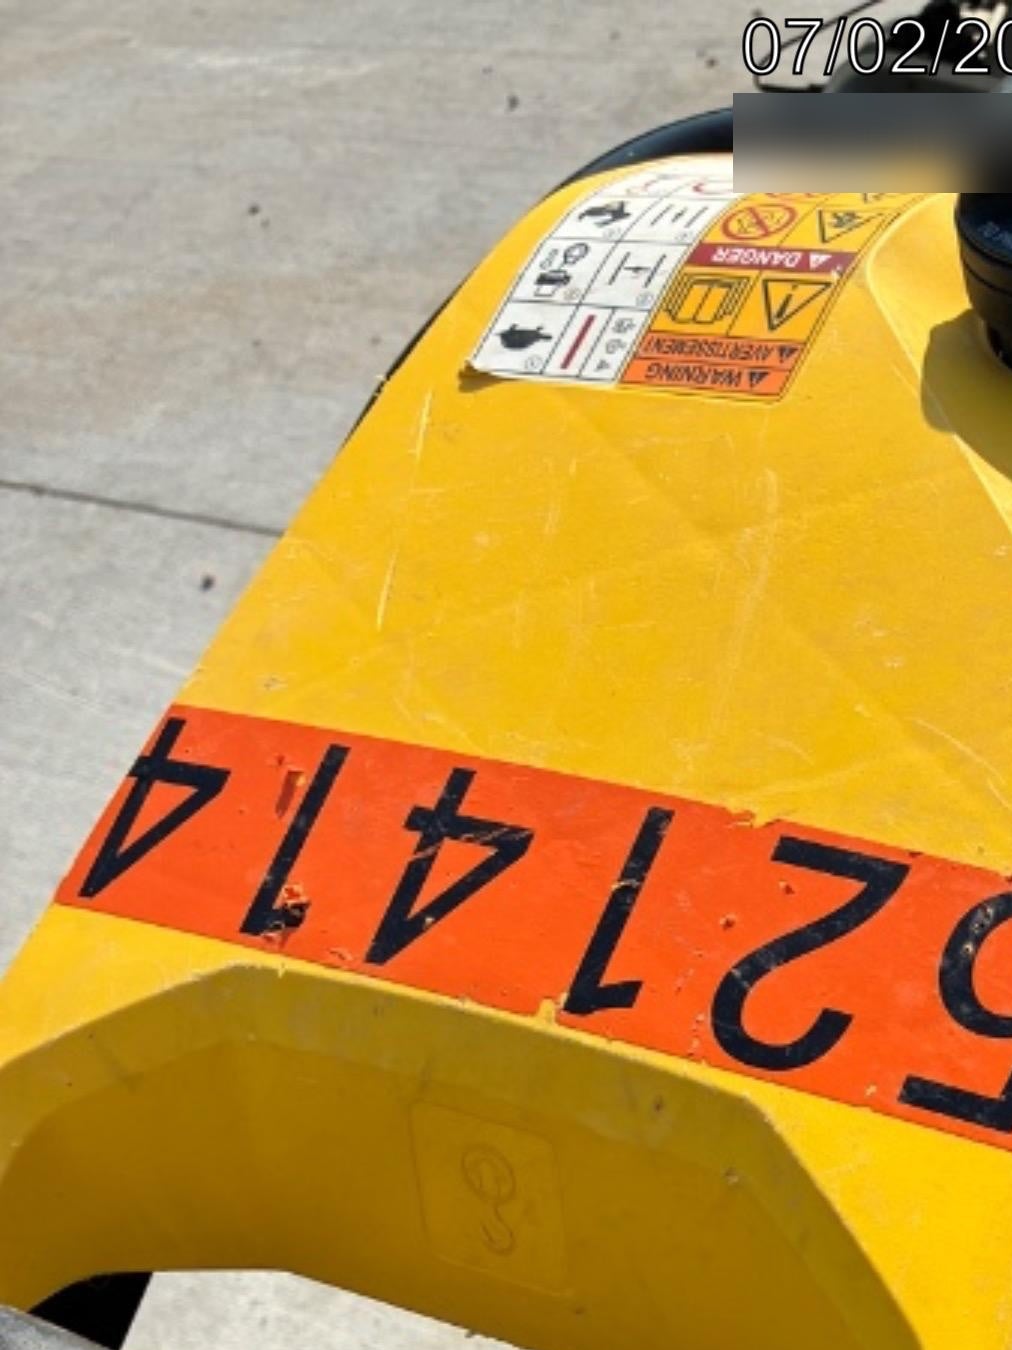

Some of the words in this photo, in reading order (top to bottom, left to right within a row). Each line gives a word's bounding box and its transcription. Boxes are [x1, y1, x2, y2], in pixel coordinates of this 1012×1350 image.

[711, 246, 803, 268] DANGER
[649, 334, 773, 360] AVERTISSEMENT
[644, 362, 742, 387] WARNING
